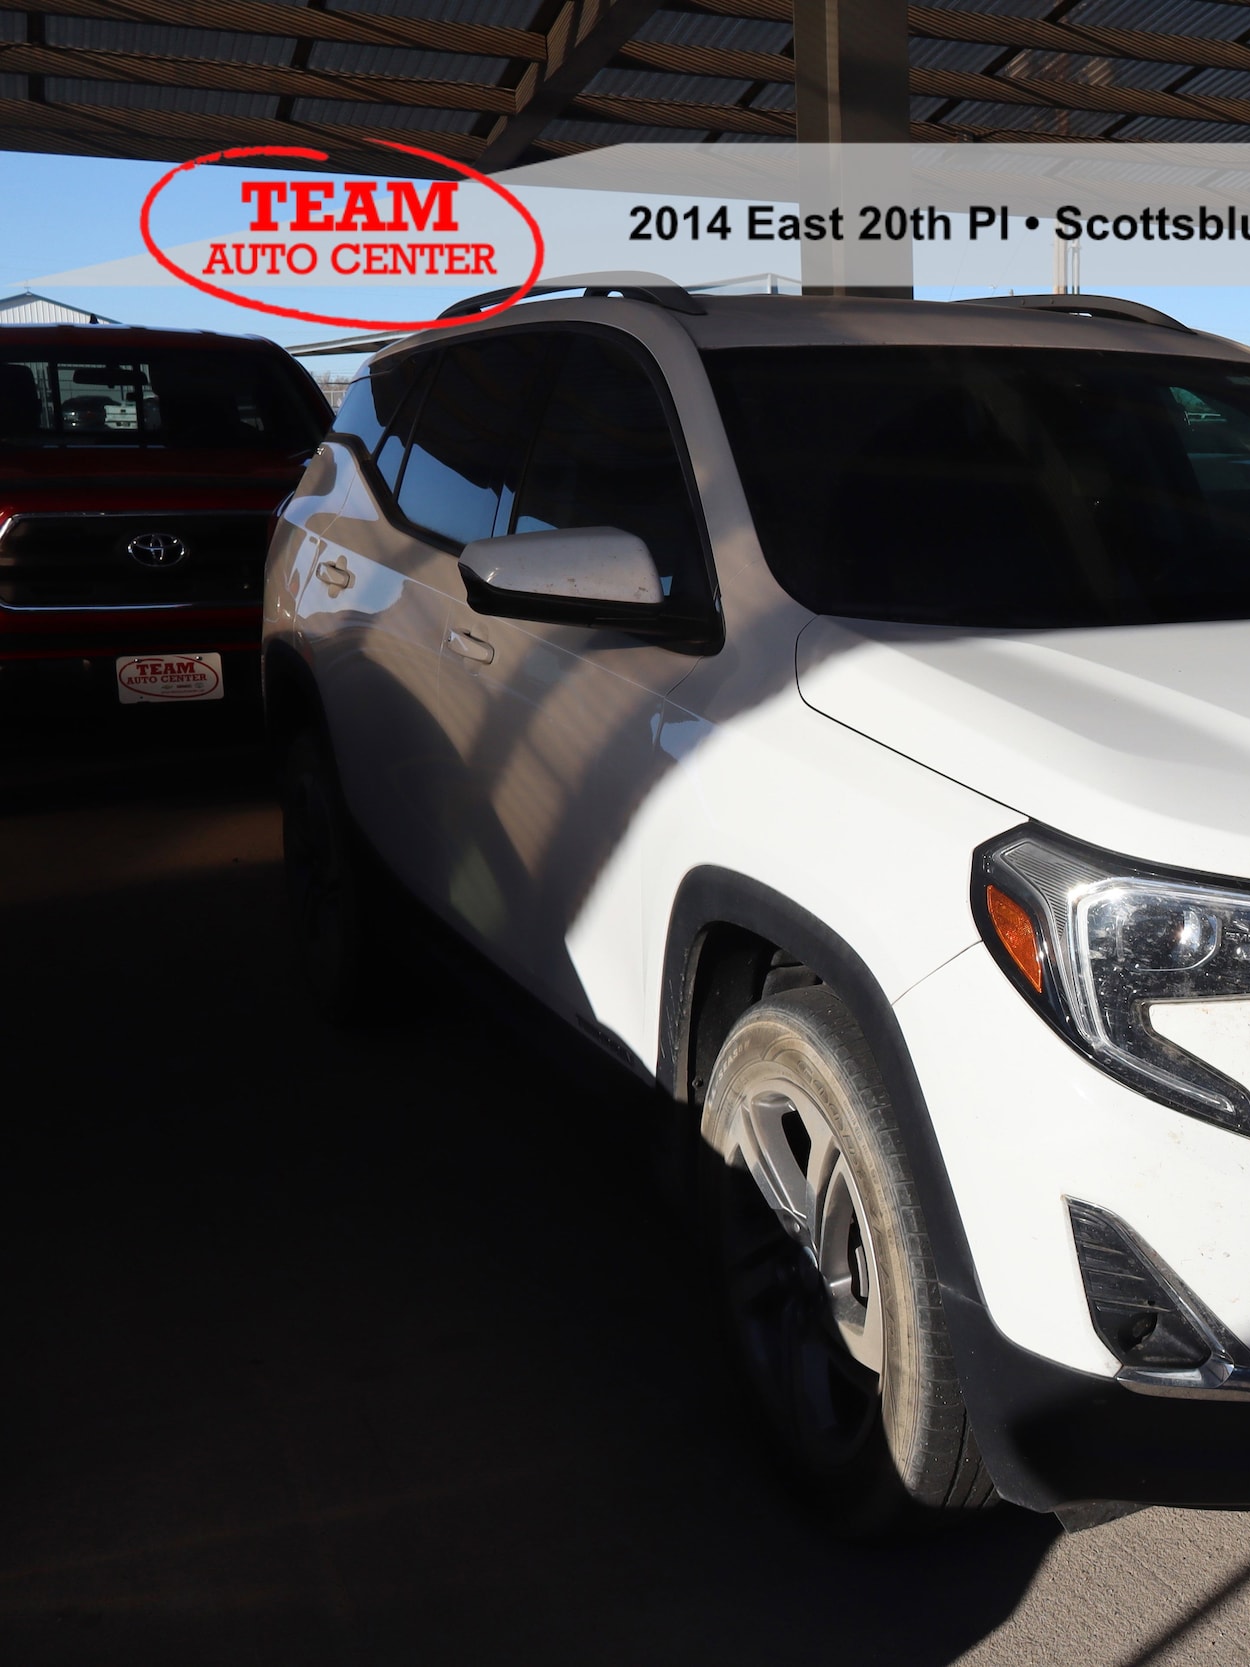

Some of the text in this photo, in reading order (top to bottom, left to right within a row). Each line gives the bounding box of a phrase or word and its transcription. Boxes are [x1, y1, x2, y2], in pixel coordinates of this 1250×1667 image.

[136, 662, 195, 676] TEAM
[127, 673, 207, 685] AUTO CENTER
